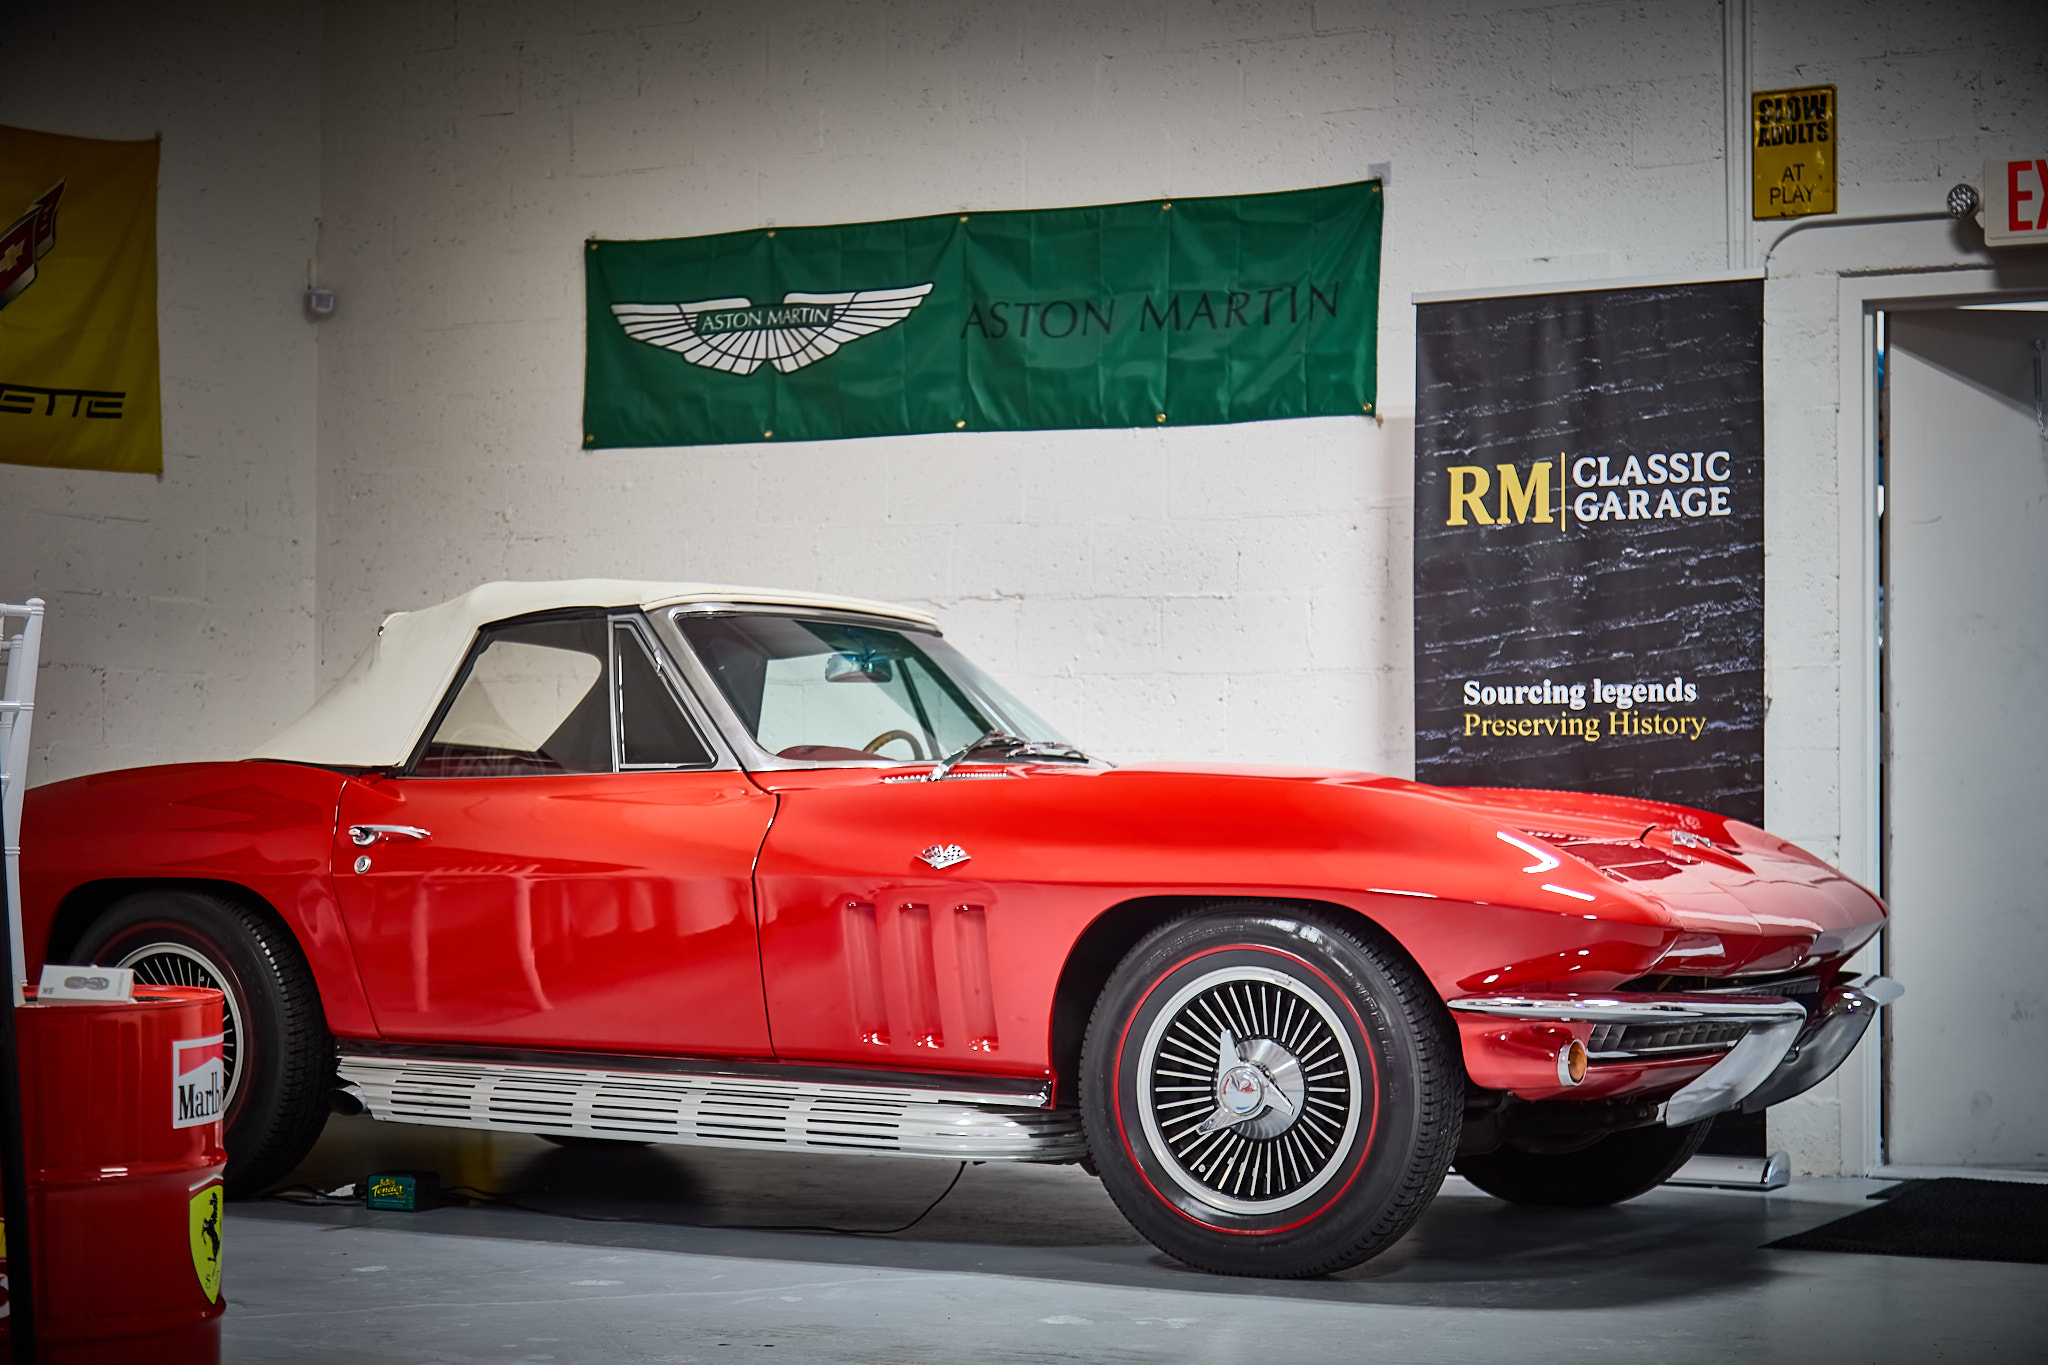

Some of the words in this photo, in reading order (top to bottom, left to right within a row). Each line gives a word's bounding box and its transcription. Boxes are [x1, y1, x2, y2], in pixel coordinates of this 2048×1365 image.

[1759, 95, 1827, 124] SLOW
[1758, 122, 1829, 147] ADULTS
[1781, 164, 1805, 182] AT
[1770, 184, 1816, 206] PLAY
[701, 310, 762, 332] ASTON
[767, 307, 831, 326] MARTIN
[961, 299, 1116, 340] ASTON
[1140, 280, 1340, 332] MARTIN
[1572, 451, 1731, 488] CLASSIC
[1446, 462, 1554, 526] RM
[1573, 486, 1732, 522] GARAGE
[1463, 679, 1587, 710] Sourcing
[1593, 677, 1698, 709] legends
[1464, 711, 1600, 742] Preserving
[1608, 711, 1707, 741] History
[178, 1071, 223, 1120] Marlb
[371, 1184, 403, 1198] Tender
